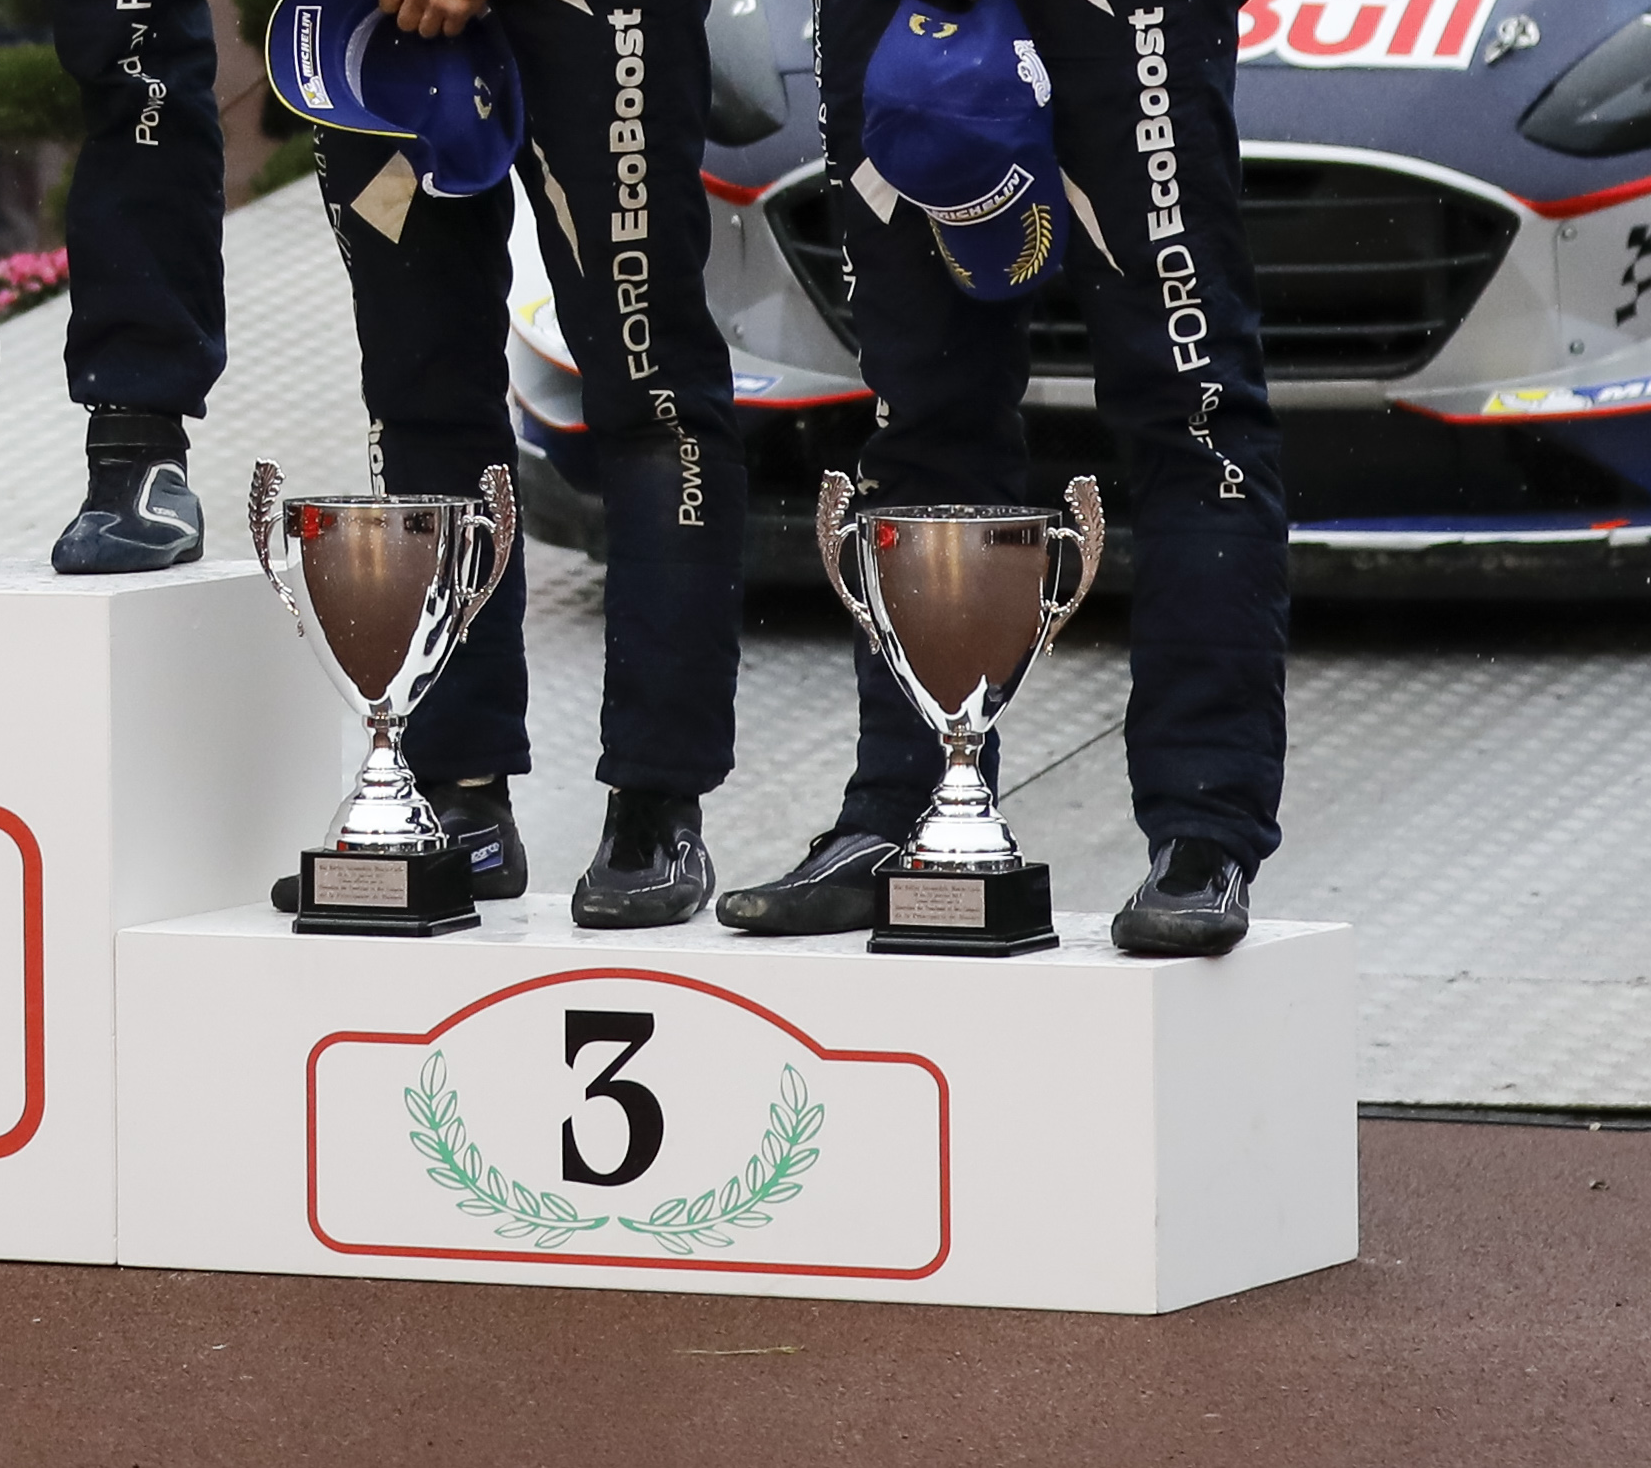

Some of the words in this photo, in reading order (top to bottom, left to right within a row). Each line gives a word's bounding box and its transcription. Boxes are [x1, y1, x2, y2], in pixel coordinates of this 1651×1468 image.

[300, 9, 313, 78] MICHELIN
[606, 8, 650, 243] EcoBoost
[1128, 5, 1189, 242] EcoBoost
[932, 167, 1025, 222] MICHELIN
[612, 250, 655, 381] FORD
[1155, 243, 1211, 373] FORD
[561, 1009, 666, 1188] 3
